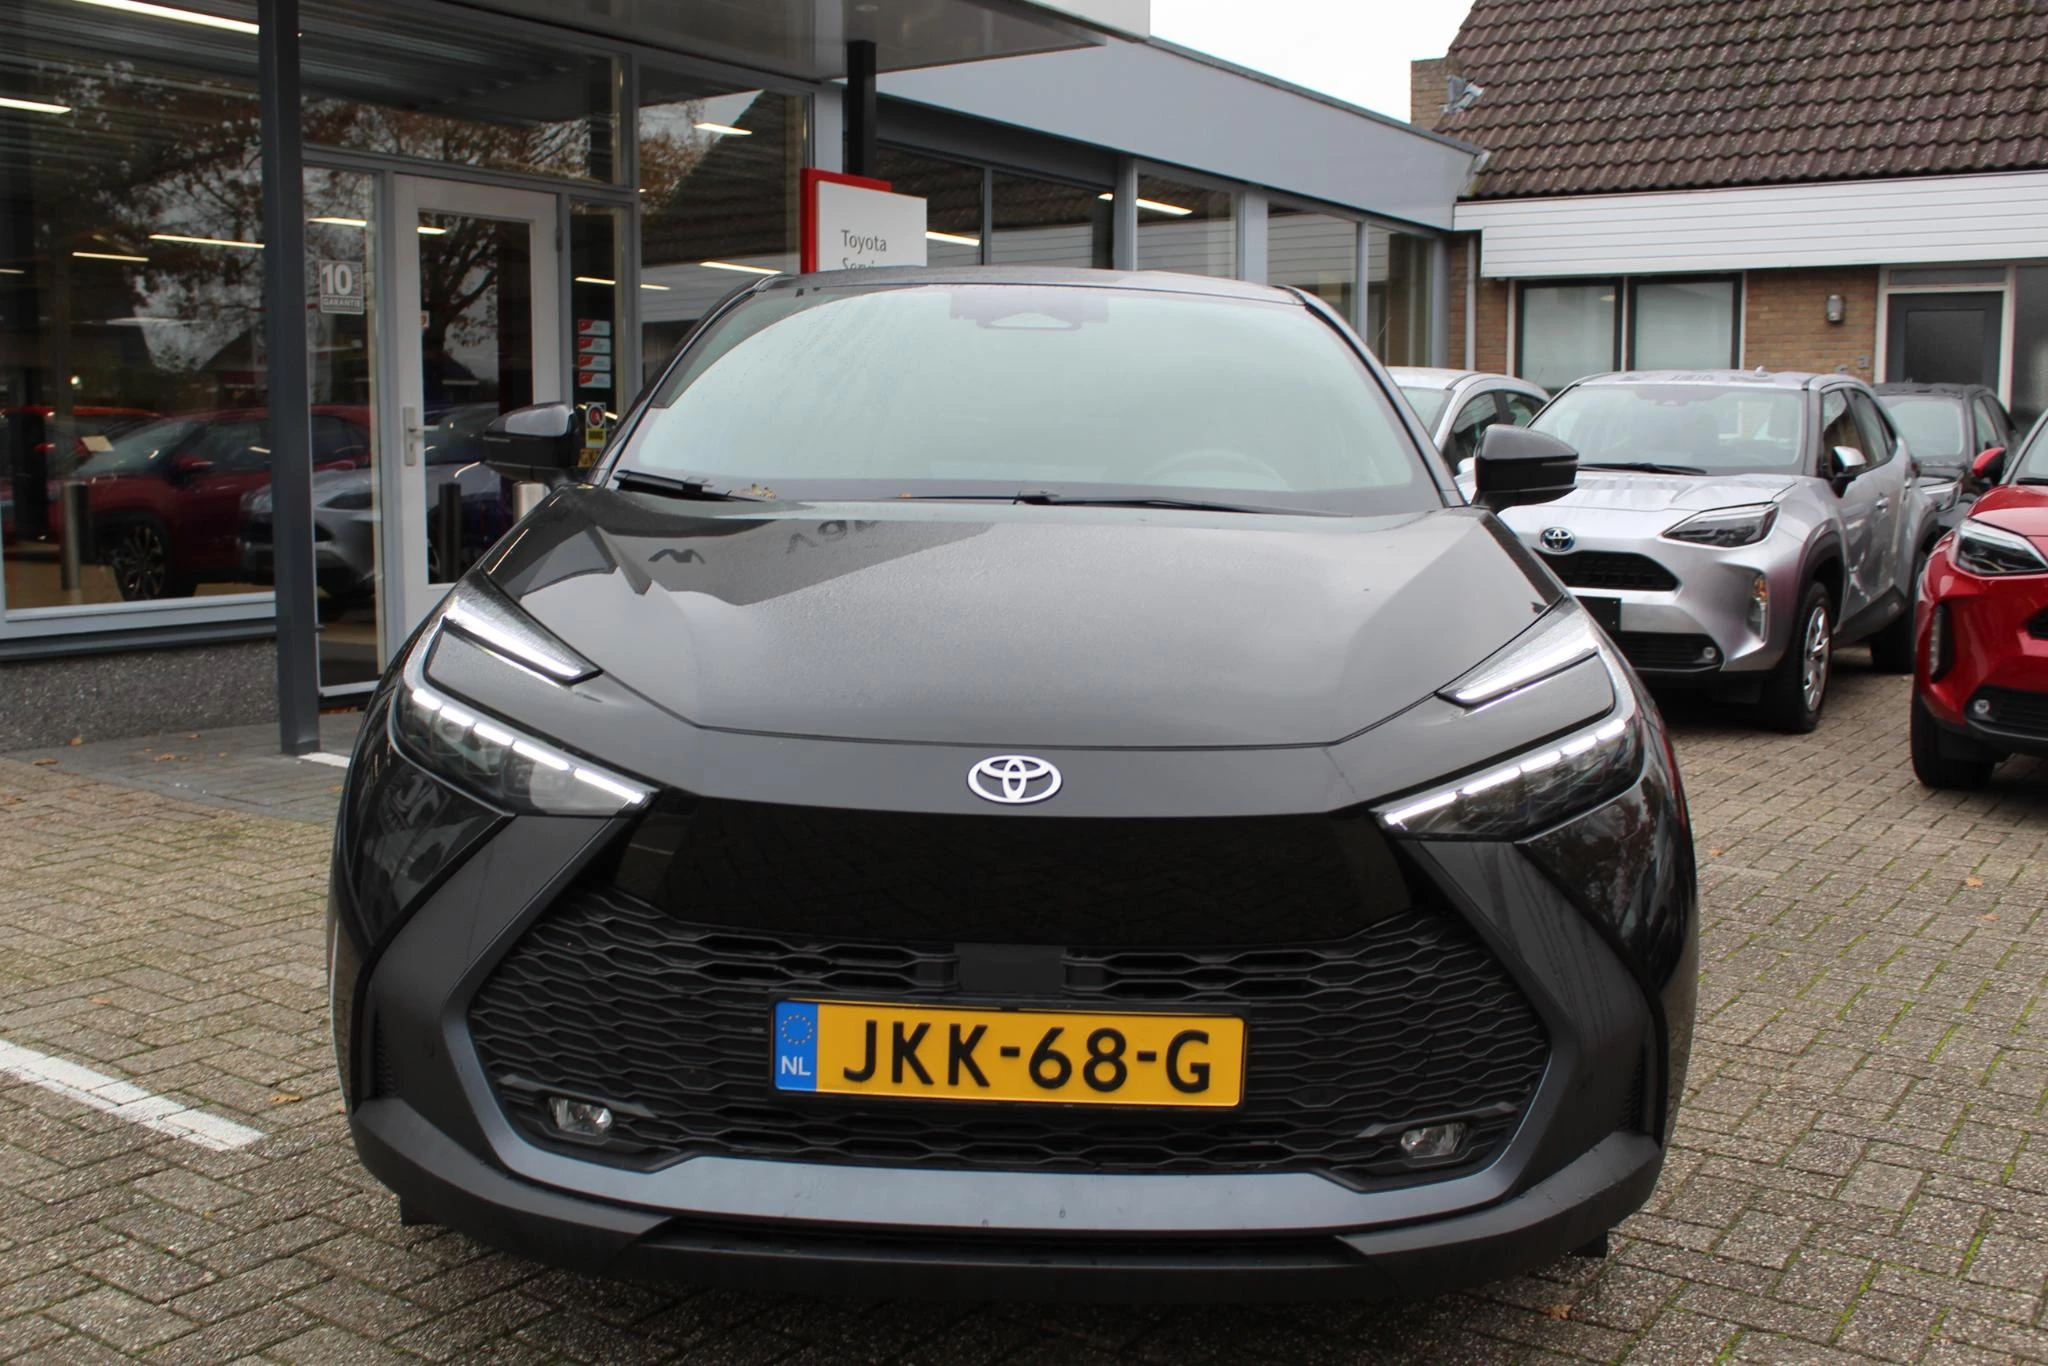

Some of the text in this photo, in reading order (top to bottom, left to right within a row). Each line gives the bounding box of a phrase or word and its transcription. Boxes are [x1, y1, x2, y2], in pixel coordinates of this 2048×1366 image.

[841, 229, 887, 254] Toyota
[322, 264, 352, 295] 10
[781, 1055, 811, 1076] NL
[843, 1020, 1211, 1093] JKK-68-G
